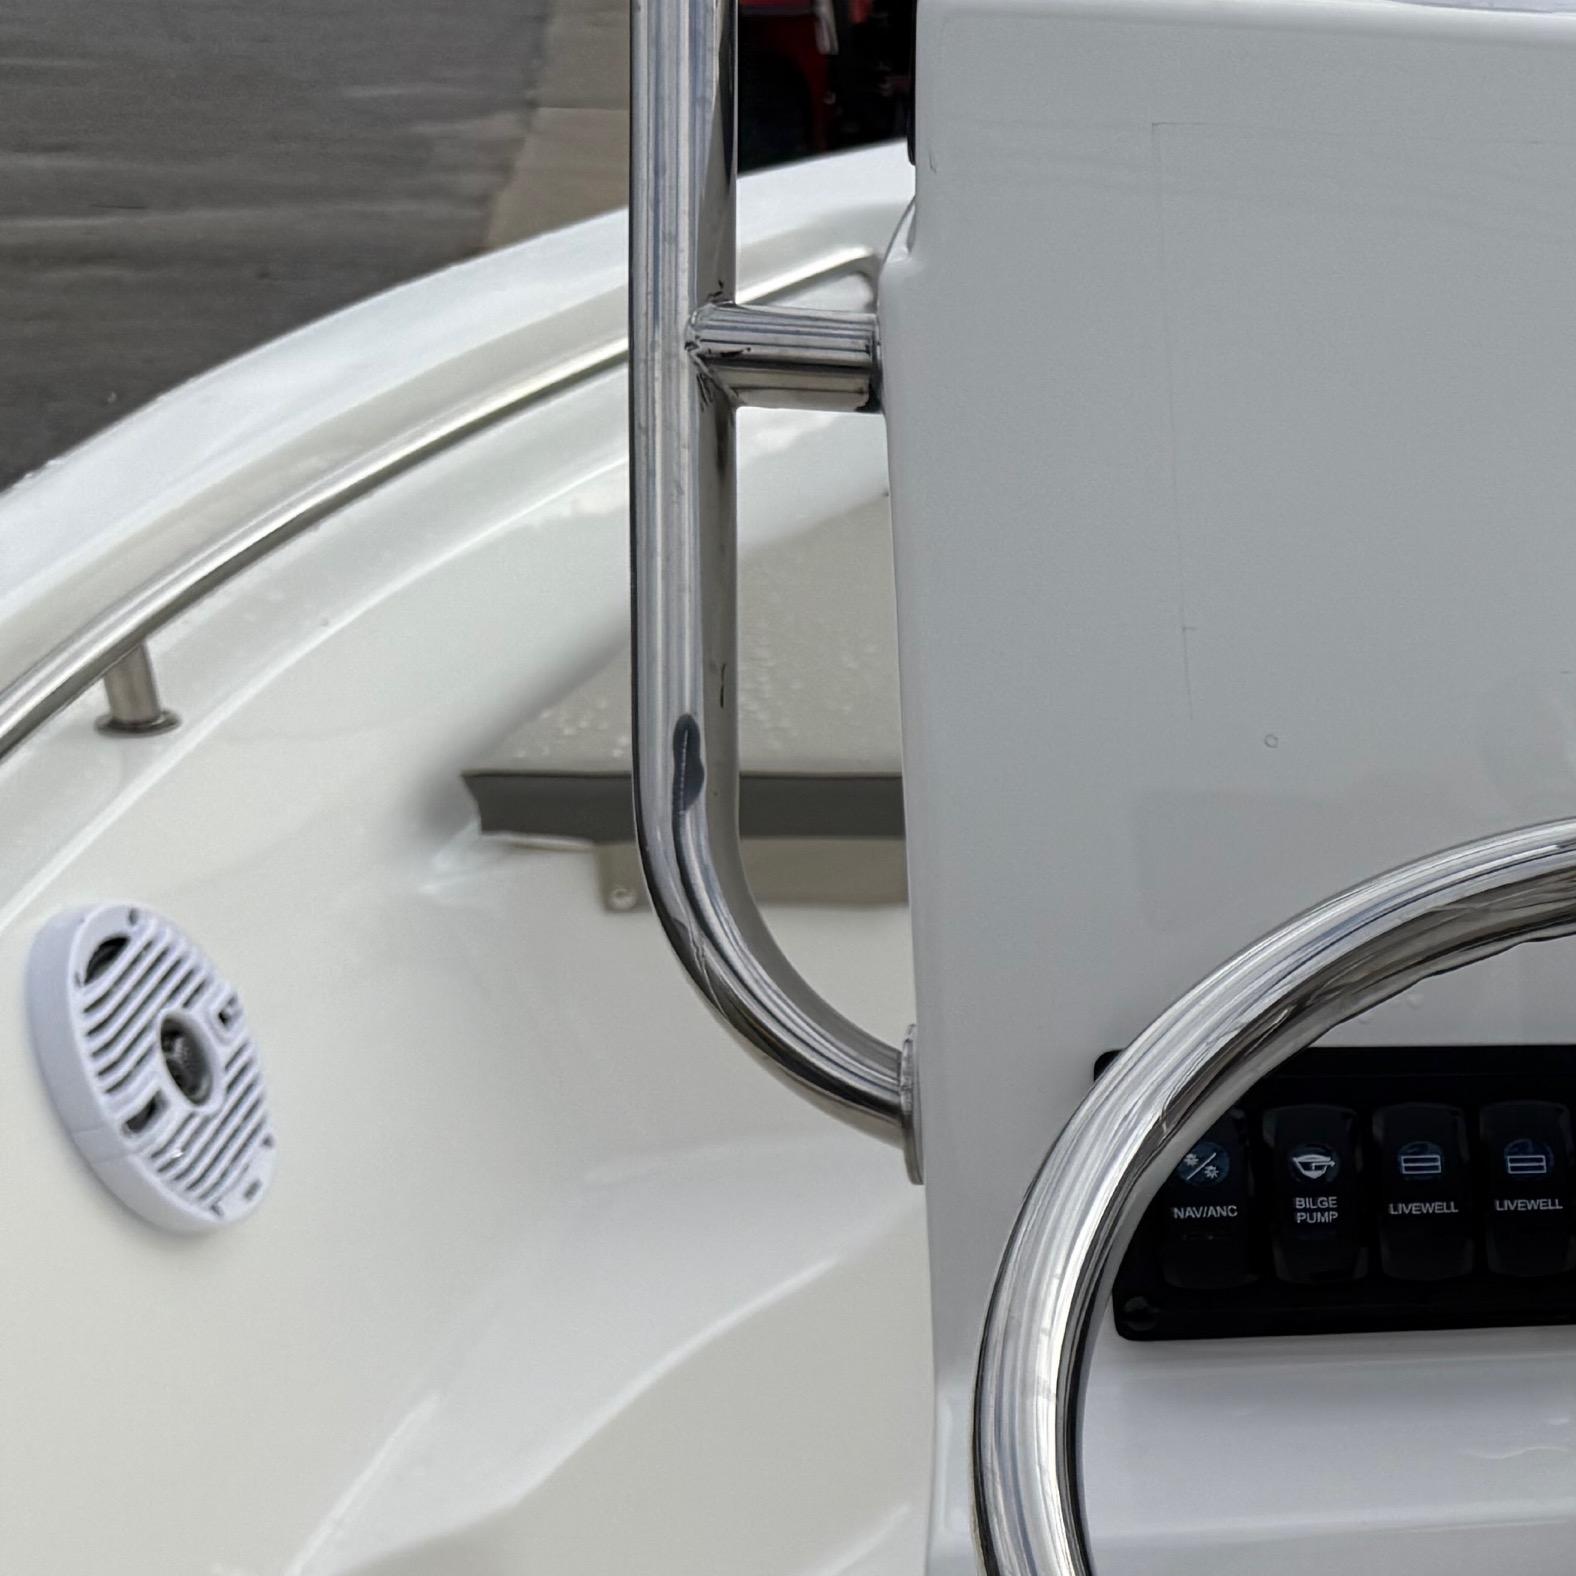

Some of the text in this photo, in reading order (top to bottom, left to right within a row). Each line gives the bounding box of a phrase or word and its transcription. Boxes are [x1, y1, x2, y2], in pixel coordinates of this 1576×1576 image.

[1295, 1195, 1338, 1209] BILGE
[1388, 1201, 1459, 1215] LIVEWELL
[1495, 1198, 1563, 1212] LIVEWELL
[1173, 1204, 1238, 1219] NAV/ANC
[1296, 1210, 1339, 1224] PUMP
